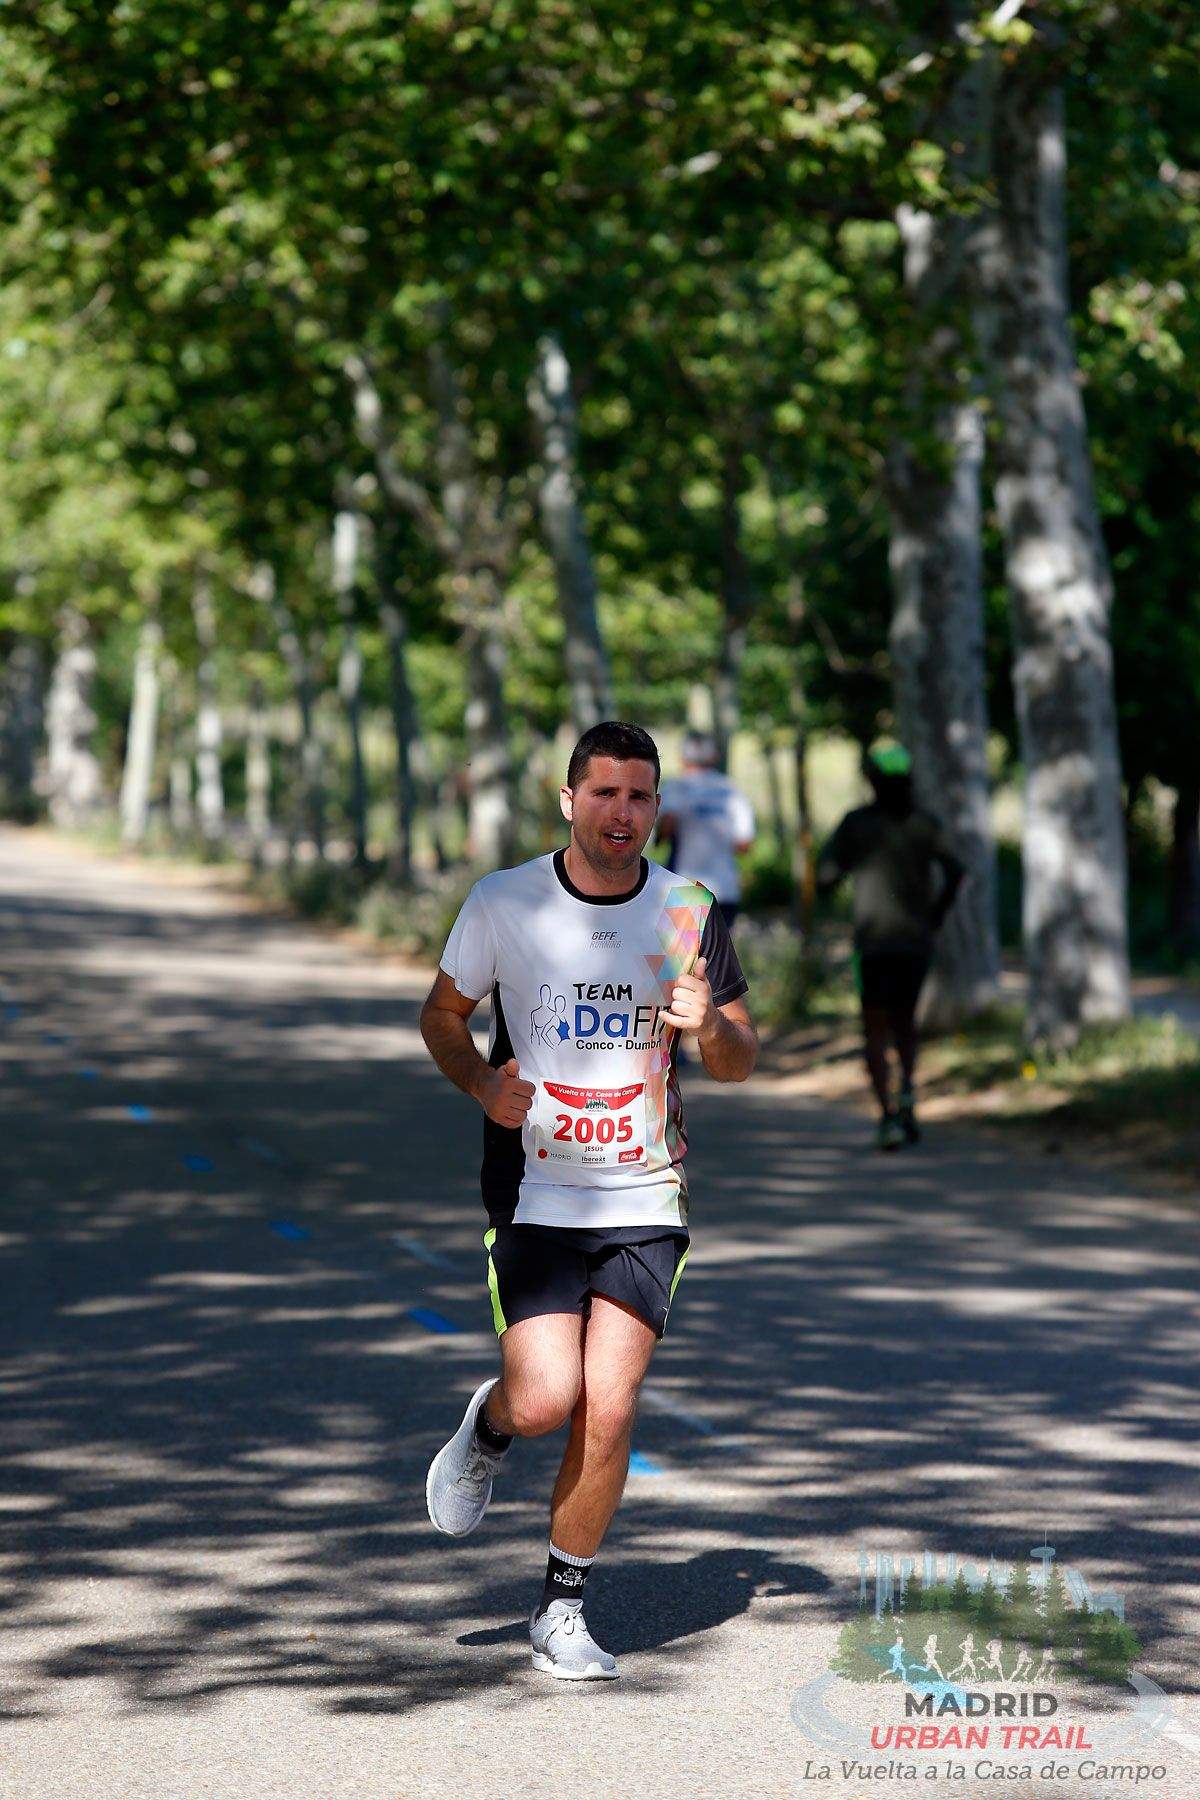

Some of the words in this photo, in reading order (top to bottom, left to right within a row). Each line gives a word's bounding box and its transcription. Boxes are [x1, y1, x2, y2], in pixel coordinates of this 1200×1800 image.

[592, 931, 617, 940] GEFF
[590, 941, 622, 949] RUNNING
[573, 983, 633, 1001] TEAM
[576, 1040, 614, 1050] Conco
[559, 1087, 579, 1096] Vuelta
[595, 1089, 613, 1098] Casa
[553, 1114, 633, 1144] 2005
[550, 1153, 572, 1161] MADRID
